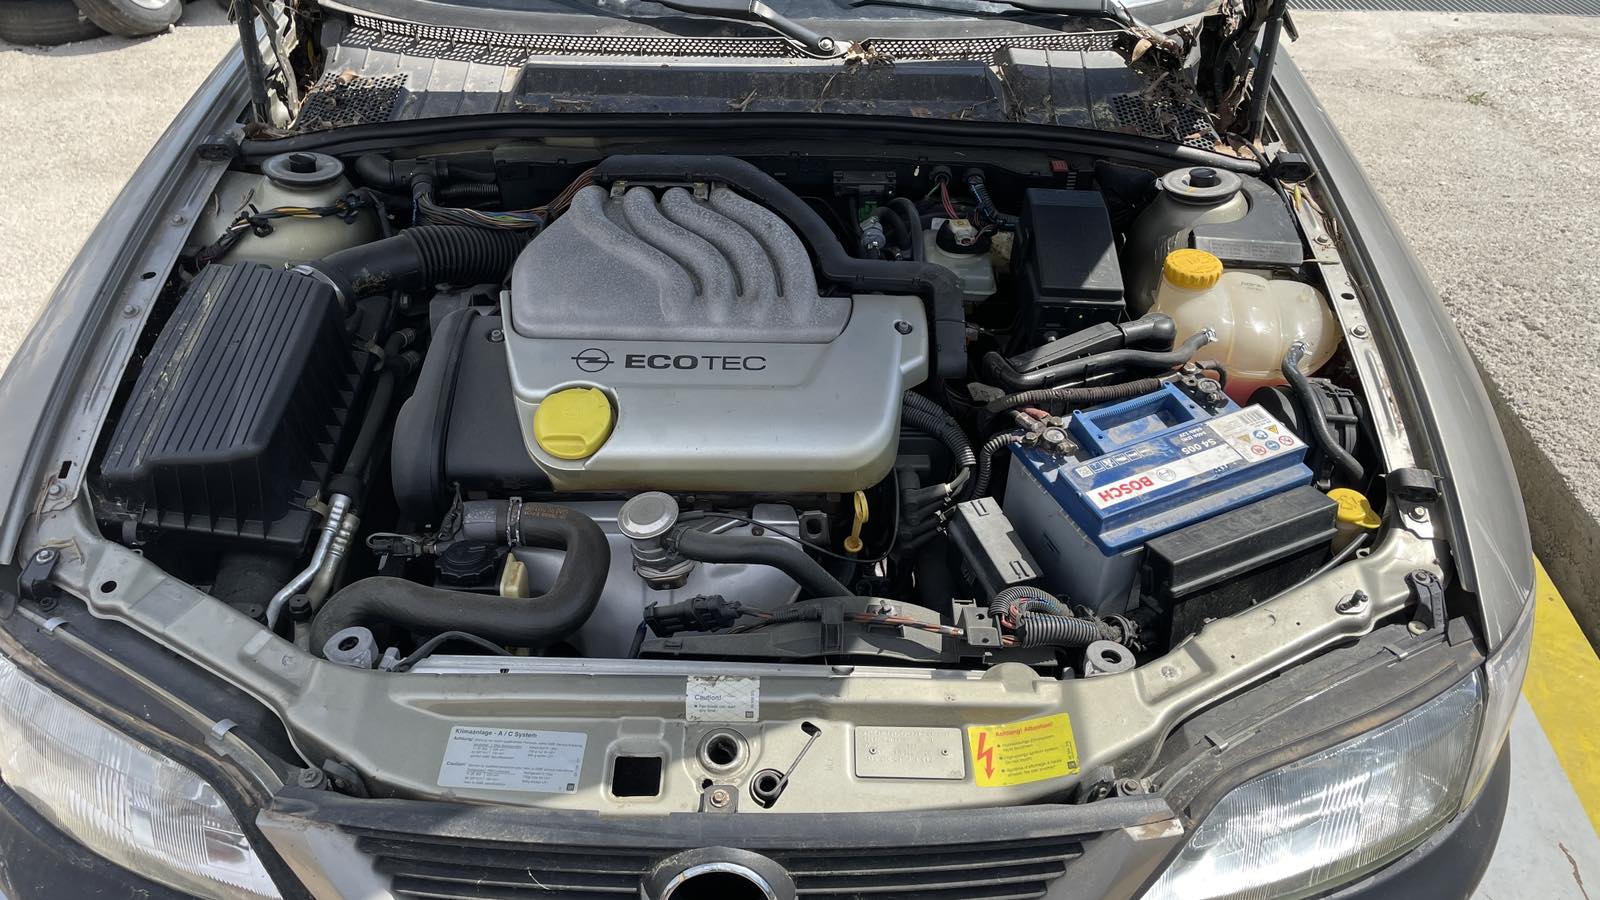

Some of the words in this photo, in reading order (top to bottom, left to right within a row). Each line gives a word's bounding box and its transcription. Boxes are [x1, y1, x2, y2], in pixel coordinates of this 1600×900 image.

[624, 354, 767, 371] ECOTEC
[1202, 438, 1217, 448] S4
[1181, 444, 1202, 455] 005
[1098, 476, 1154, 502] BOSCH
[455, 728, 493, 736] Klimaanlage
